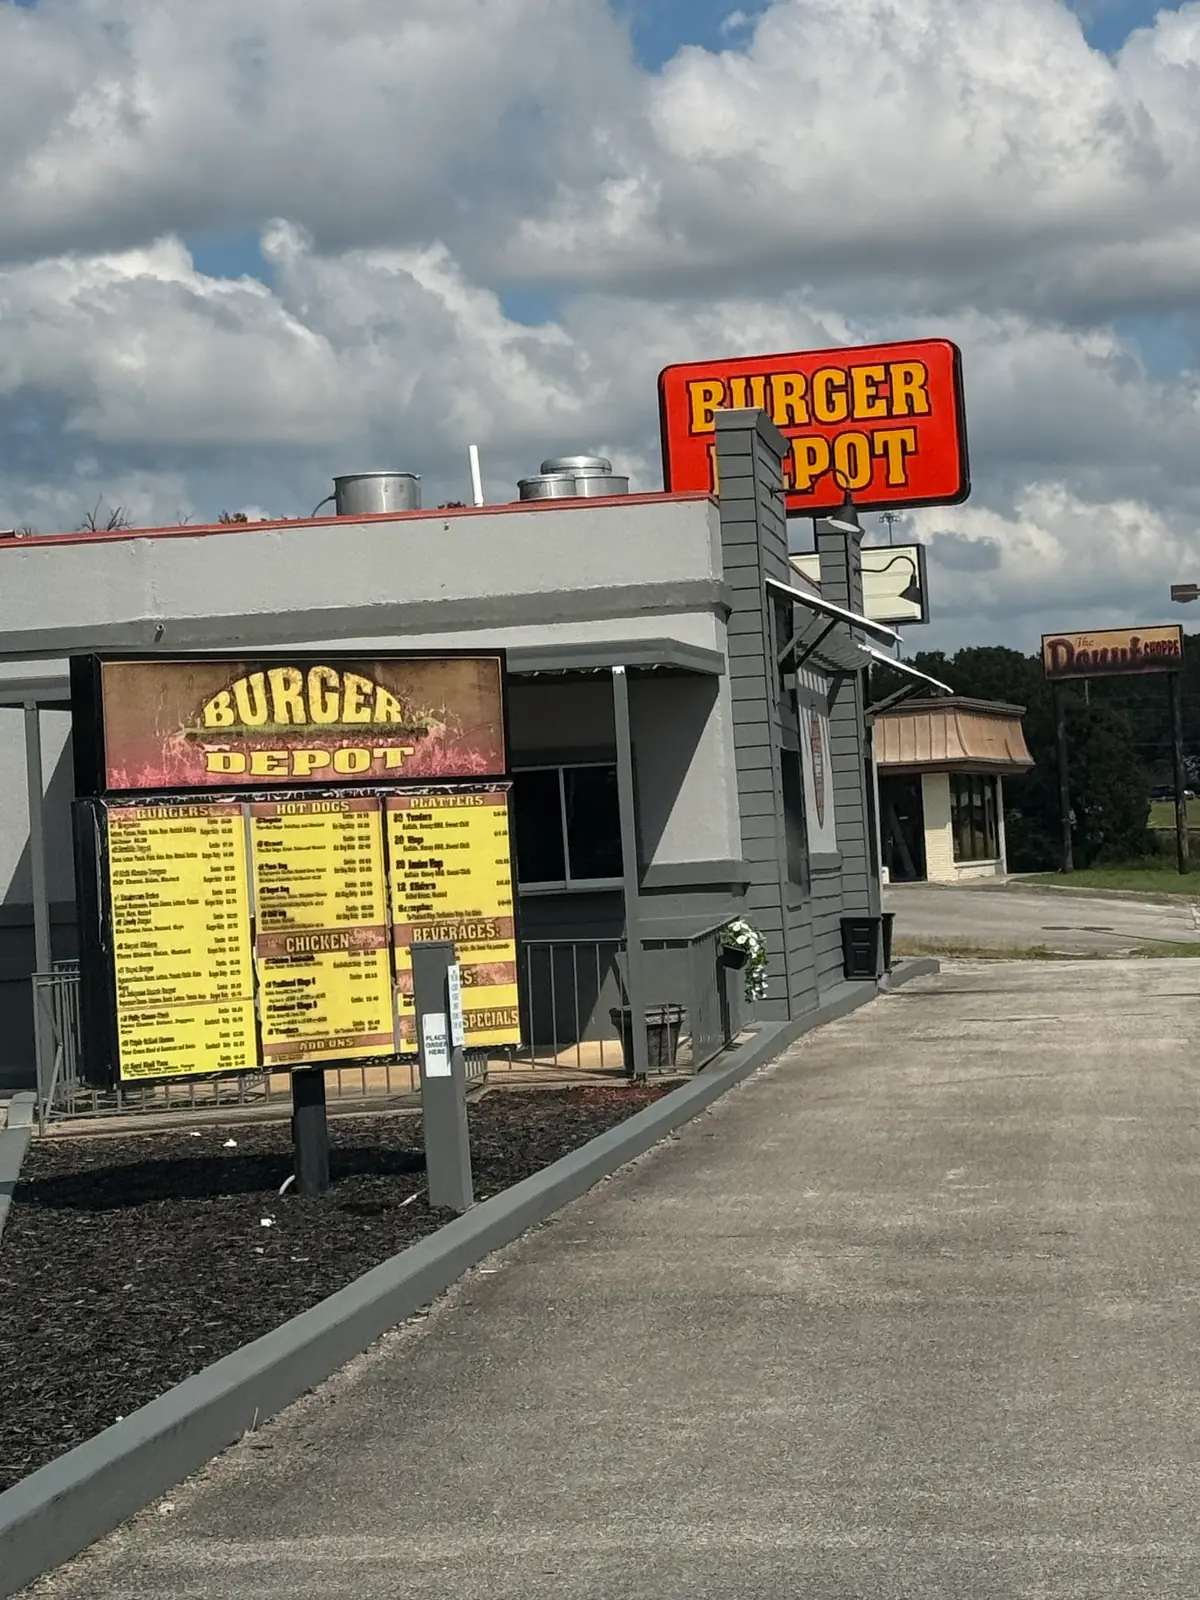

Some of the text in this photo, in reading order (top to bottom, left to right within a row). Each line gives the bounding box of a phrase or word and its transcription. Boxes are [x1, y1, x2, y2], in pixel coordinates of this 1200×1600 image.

[687, 360, 931, 433] BURGER
[203, 665, 404, 728] BURGER
[205, 747, 415, 777] DEPOT
[277, 801, 350, 815] HOT DOGS
[410, 796, 484, 808] PLATTERS
[136, 806, 209, 820] BURGERS
[286, 934, 350, 952] CHICKEN
[300, 1042, 325, 1051] ADD
